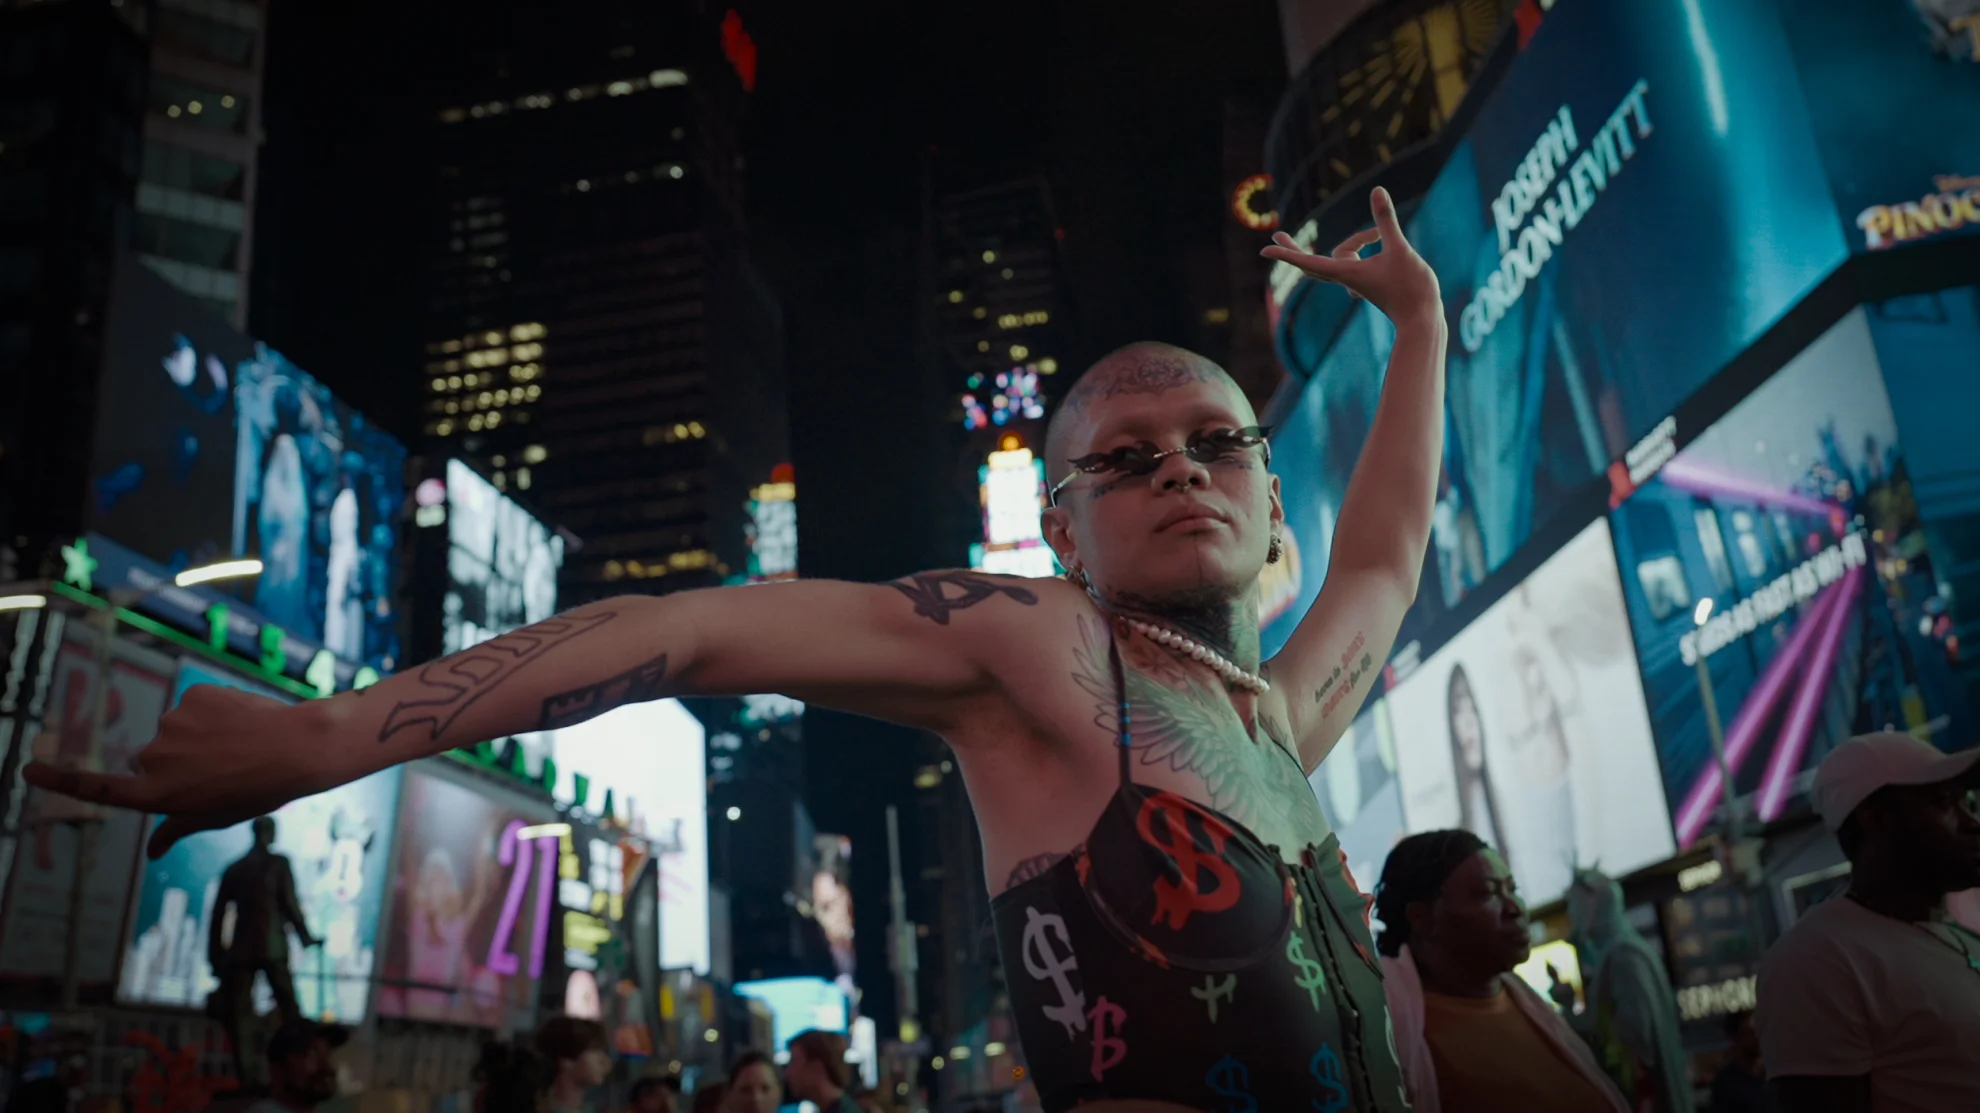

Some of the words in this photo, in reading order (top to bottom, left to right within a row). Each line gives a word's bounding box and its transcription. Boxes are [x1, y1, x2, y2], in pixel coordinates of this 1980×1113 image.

[1459, 75, 1656, 353] GORDON-LEVITT
[1491, 103, 1579, 257] JOSEPH
[487, 818, 559, 980] 21
